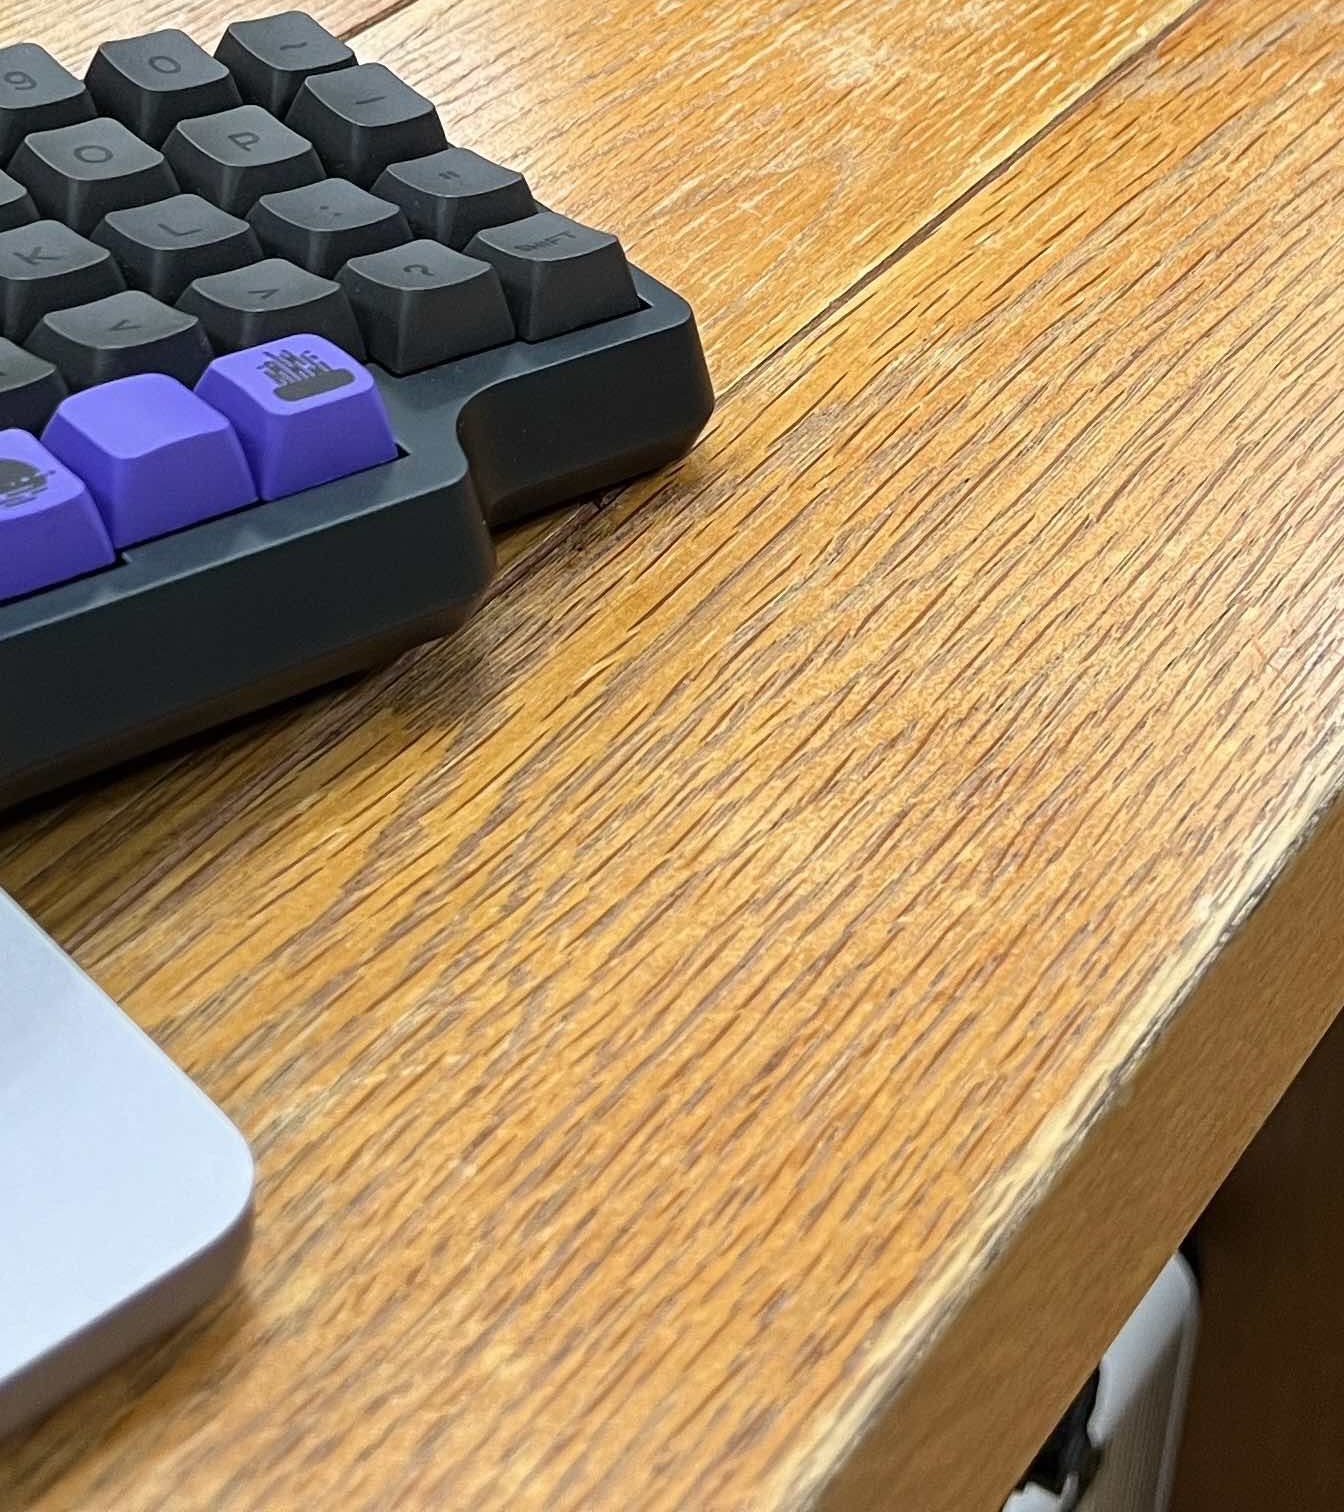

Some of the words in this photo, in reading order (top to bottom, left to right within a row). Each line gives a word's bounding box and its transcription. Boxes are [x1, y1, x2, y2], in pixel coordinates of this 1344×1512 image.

[3, 71, 38, 91] 9
[227, 130, 261, 152] P
[157, 222, 199, 239] L
[13, 244, 62, 267] K
